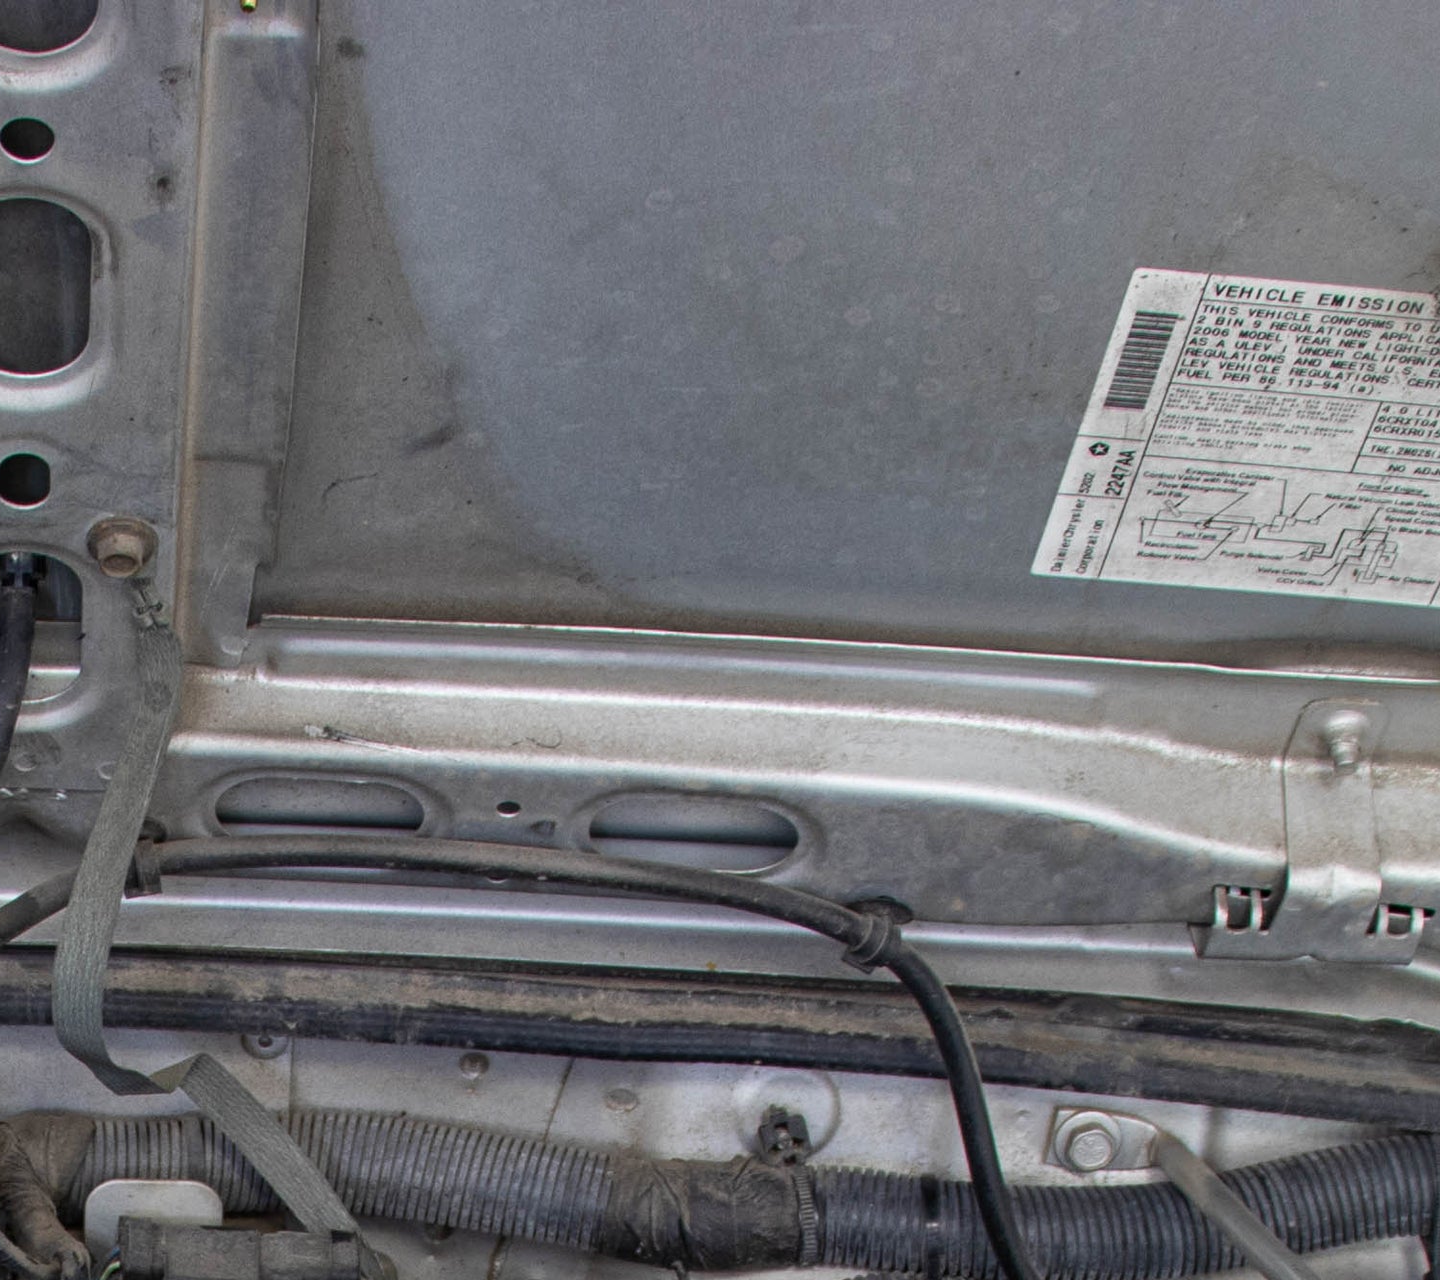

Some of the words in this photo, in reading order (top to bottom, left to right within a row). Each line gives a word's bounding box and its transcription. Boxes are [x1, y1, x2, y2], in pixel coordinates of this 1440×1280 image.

[1212, 282, 1307, 304] VEHICLE
[1315, 292, 1425, 316] EMISSION
[1195, 314, 1207, 324] 2
[1214, 316, 1245, 327] BIN
[1251, 319, 1262, 329] 9
[1268, 321, 1372, 340] REGULATIONS
[1200, 302, 1240, 316] THIS
[1246, 306, 1312, 323] VEHICLE
[1318, 313, 1396, 331] CONFORMS
[1402, 322, 1423, 333] TO
[1188, 335, 1209, 346] AS
[1214, 338, 1227, 348] A
[1233, 340, 1271, 352] ULEV
[1296, 346, 1345, 359] UNDER
[1191, 324, 1231, 338] 2006
[1237, 328, 1284, 343] MODEL
[1292, 334, 1328, 347] YEAR
[1336, 338, 1367, 350] NEW
[1180, 356, 1209, 369] LEV
[1216, 360, 1282, 375] VEHICLE
[1183, 346, 1287, 365] REGULATIONS
[1292, 356, 1323, 368] AND
[1328, 359, 1377, 373] MEETS
[1176, 367, 1215, 380] FUEL
[1221, 371, 1252, 383] PER
[1103, 448, 1137, 497] 2247AA
[1385, 463, 1407, 474] NO
